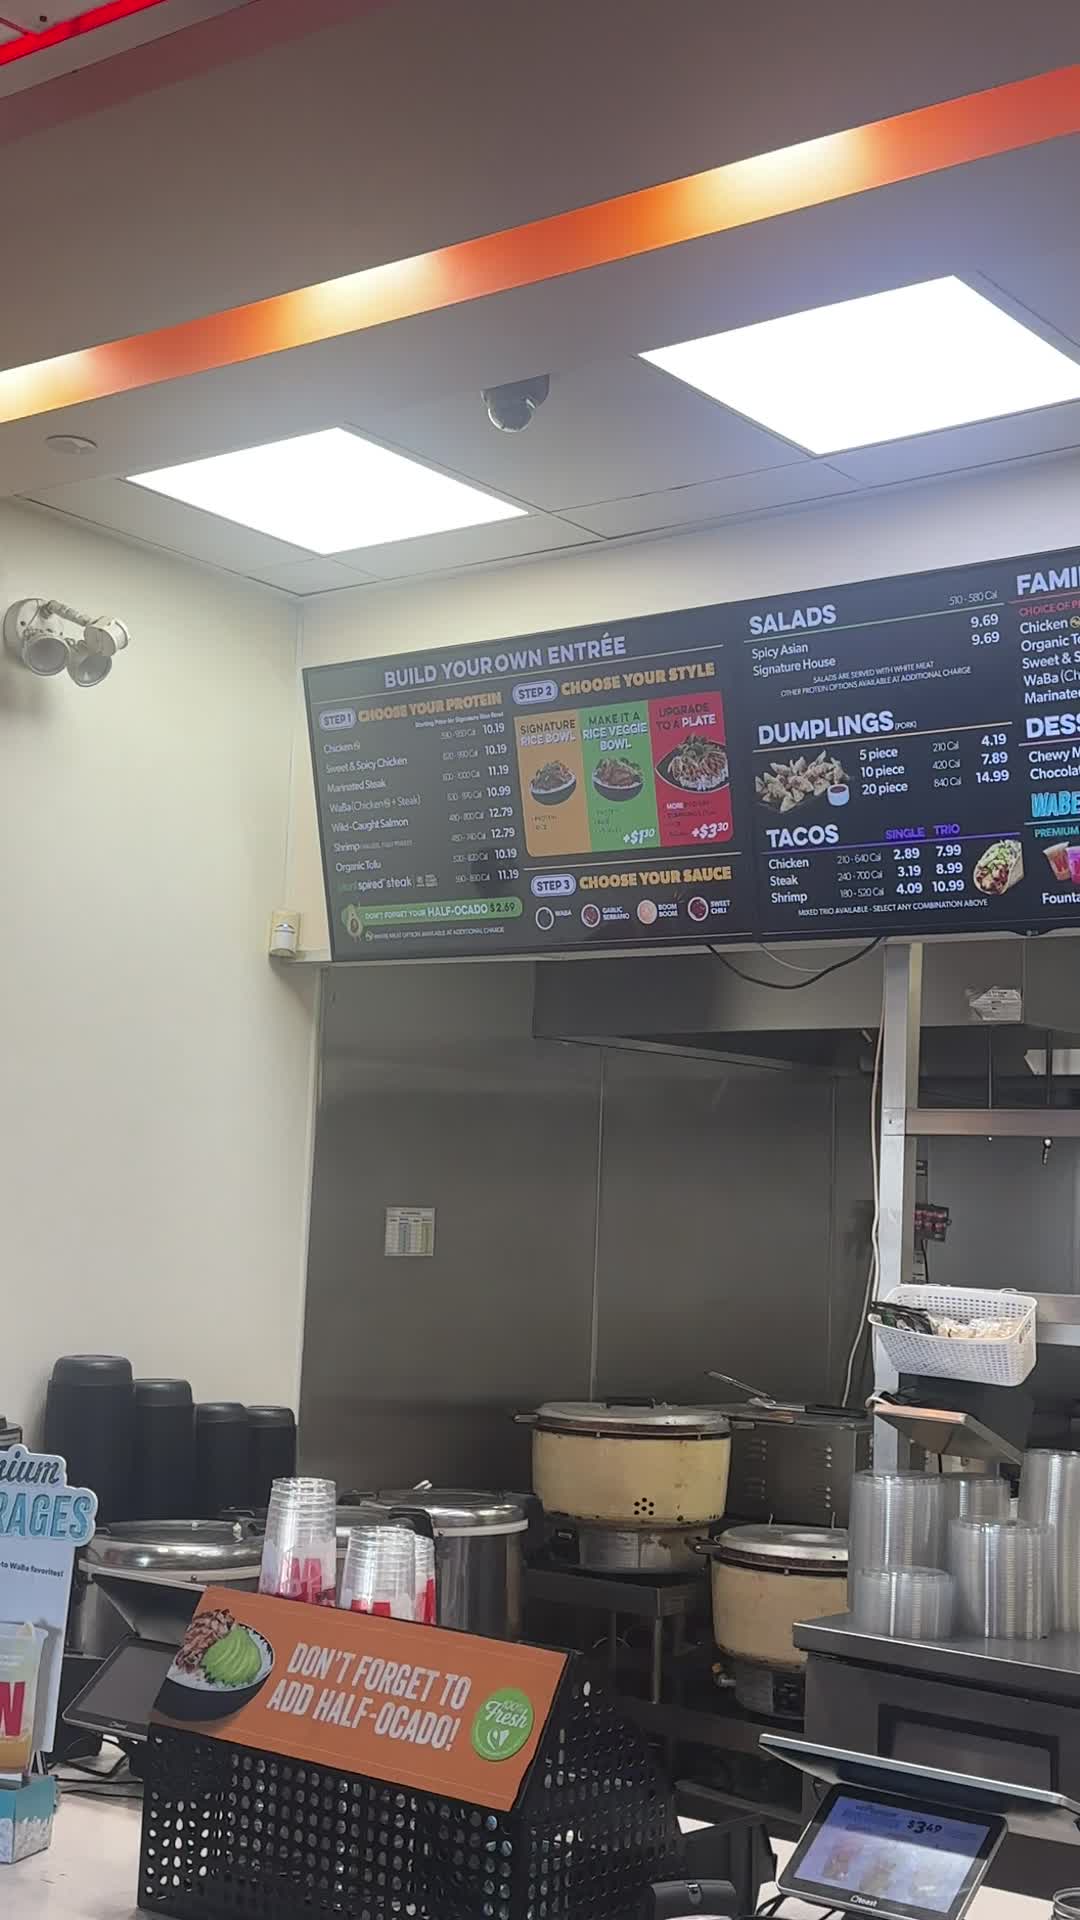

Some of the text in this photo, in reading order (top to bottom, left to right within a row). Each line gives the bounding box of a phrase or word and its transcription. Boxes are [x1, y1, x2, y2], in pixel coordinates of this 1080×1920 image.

[1019, 604, 1056, 617] CHOICE
[749, 604, 837, 636] SALADS
[970, 613, 998, 628] 9.69
[1020, 619, 1068, 634] Chicken
[971, 631, 1000, 646] 9.69
[1021, 635, 1070, 652] Organic
[752, 643, 809, 661] Spicy Asian
[384, 632, 626, 688] BUILD YOUR OWN ENTRÉE
[753, 657, 836, 678] Signature House
[1022, 653, 1060, 669] Sweet
[1061, 652, 1071, 664] &
[518, 662, 715, 699] STEP 2 CHOOSE YOUR STYLE
[813, 674, 837, 683] SALADS
[1023, 672, 1059, 686] WaBa
[1024, 689, 1080, 704] Marinate
[323, 715, 345, 726] STEP
[409, 700, 444, 716] YOUR
[446, 692, 502, 711] PROTEIN
[659, 703, 709, 717] UPGRADE
[588, 711, 641, 725] MAKE IT A
[656, 721, 671, 730] TO
[681, 714, 716, 728] PLATE
[1026, 713, 1080, 738] DES
[482, 723, 504, 734] 10.19
[520, 720, 575, 735] SIGNATURE
[582, 722, 648, 740] RICE VEGGIE
[758, 710, 894, 745] DUMPLINGS
[520, 731, 576, 747] RICE BOWL
[600, 738, 632, 752] BOWL
[981, 733, 1007, 746] 4.19
[485, 744, 507, 755] 10.19
[860, 748, 898, 761] 5 piece
[1028, 750, 1070, 763] Chewy
[981, 751, 1008, 765] 7.89
[488, 765, 509, 776] 11.19
[861, 765, 905, 778] 10 piece
[976, 769, 1010, 784] 14.99
[487, 786, 511, 797] 10.99
[862, 782, 908, 796] 20 piece
[489, 806, 513, 818] 12.79
[380, 818, 408, 829] Salmon
[491, 827, 515, 838] 12.79
[766, 824, 840, 848] TACOS
[885, 824, 960, 840] SINGLE TRIO
[1034, 826, 1080, 838] PREMIUM
[495, 848, 517, 859] 10.19
[893, 844, 961, 860] 2.89 7.99
[769, 858, 809, 869] Chicken
[898, 862, 963, 877] 3.19 8.99
[498, 869, 519, 880] 11.19
[537, 866, 732, 892] STEP 3 CHOOSE YOUR SAUCE
[770, 875, 799, 887] Steak
[896, 880, 965, 895] 4.09 10.99
[771, 892, 808, 904] Shrimp
[427, 903, 488, 917] HALF-OCADO
[490, 902, 515, 913] $2.69
[819, 907, 834, 915] TRIO
[835, 905, 868, 914] AVAILABLE
[872, 904, 896, 912] SELECT
[897, 903, 911, 911] ANY
[912, 901, 963, 910] COMBINATION
[964, 899, 988, 907] ABOVE
[0, 1451, 60, 1484] ium
[287, 1643, 472, 1710] DON'T FORGET TO
[266, 1679, 462, 1751] ADD HALF-OCADO!
[485, 1700, 528, 1729] Fresh
